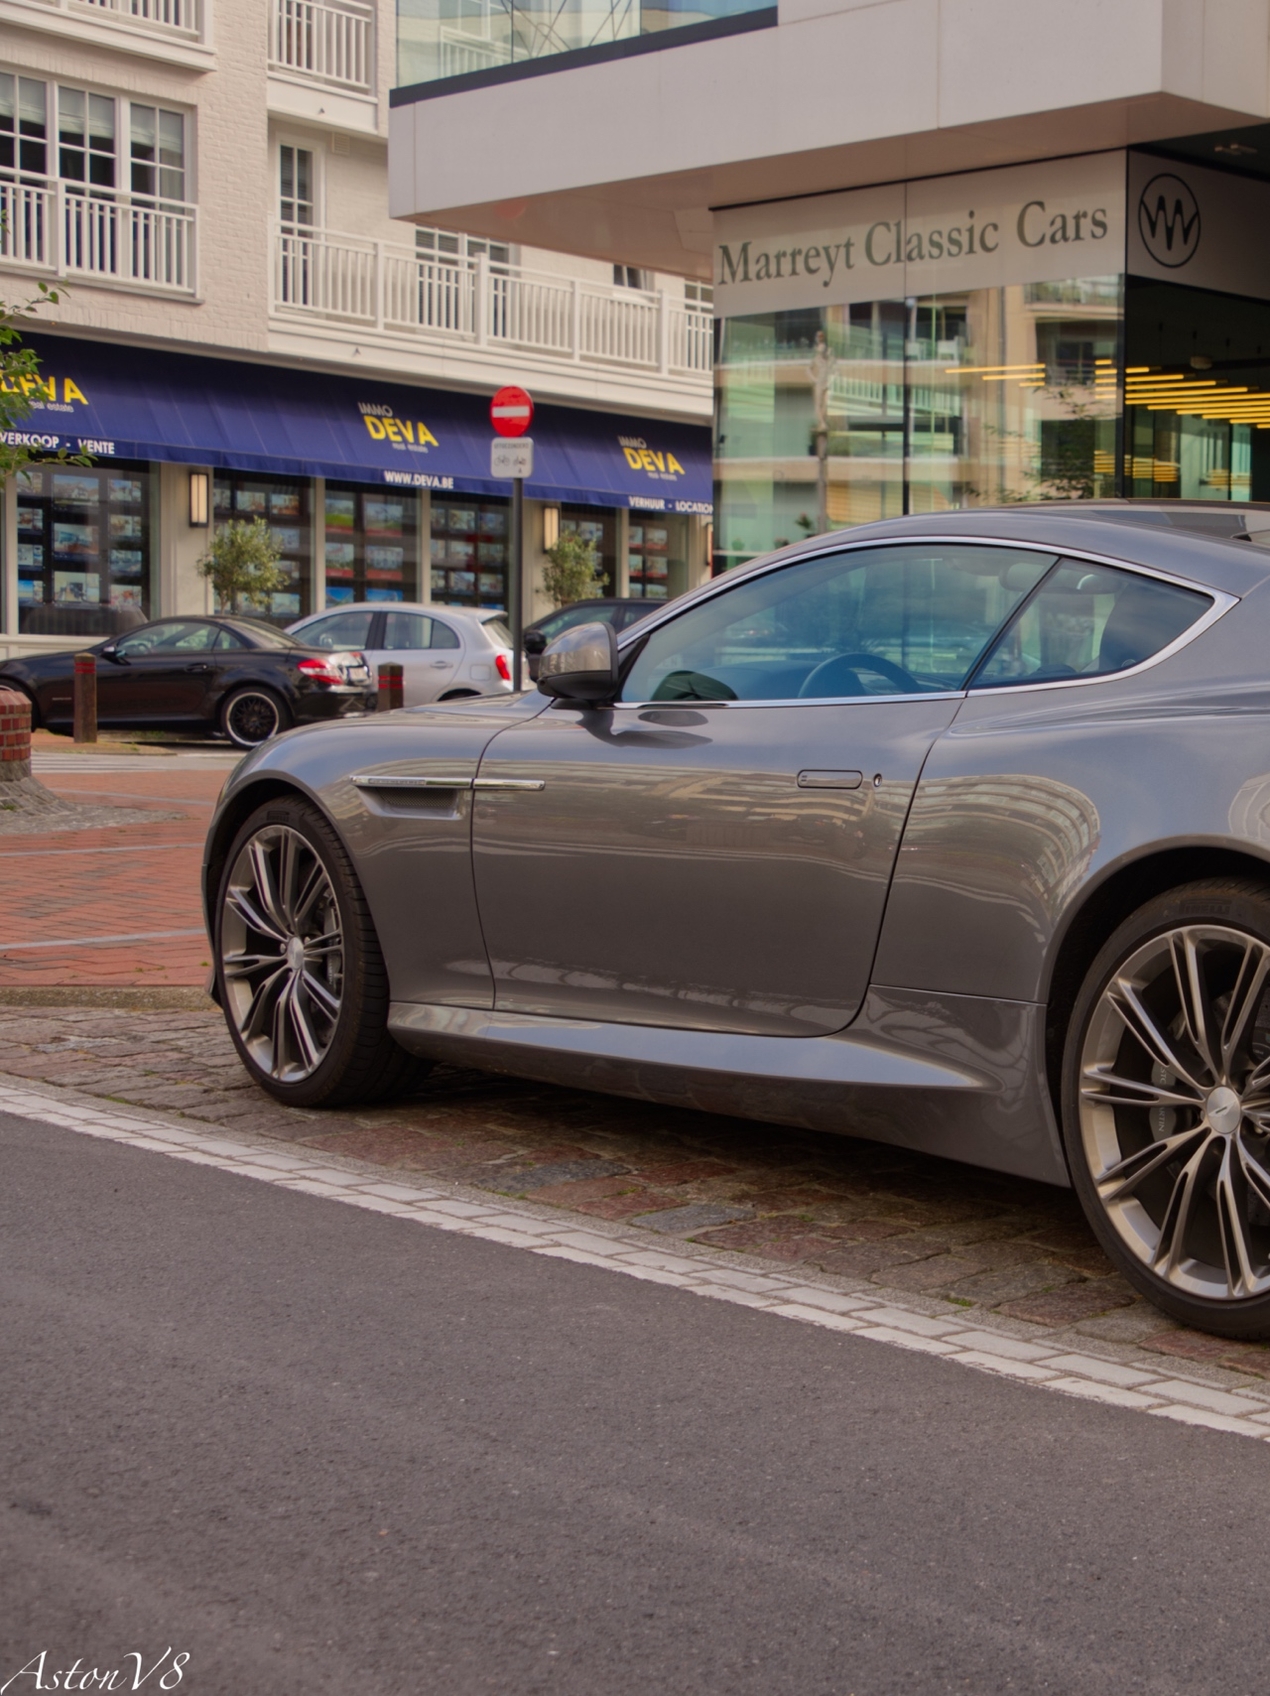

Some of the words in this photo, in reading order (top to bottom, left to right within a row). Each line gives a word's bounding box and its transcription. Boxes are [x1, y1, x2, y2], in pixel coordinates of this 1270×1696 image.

[718, 236, 856, 288] Marreyt
[865, 210, 999, 267] Classic
[1017, 201, 1108, 248] Cars
[358, 402, 393, 417] IMMO
[0, 431, 60, 449] VERKOOP
[78, 438, 115, 454] VENTE
[363, 415, 439, 447] DEVA
[623, 447, 686, 475] DEVA
[384, 470, 454, 489] WWW.DEVA.BE
[628, 496, 665, 510] VERHUUR
